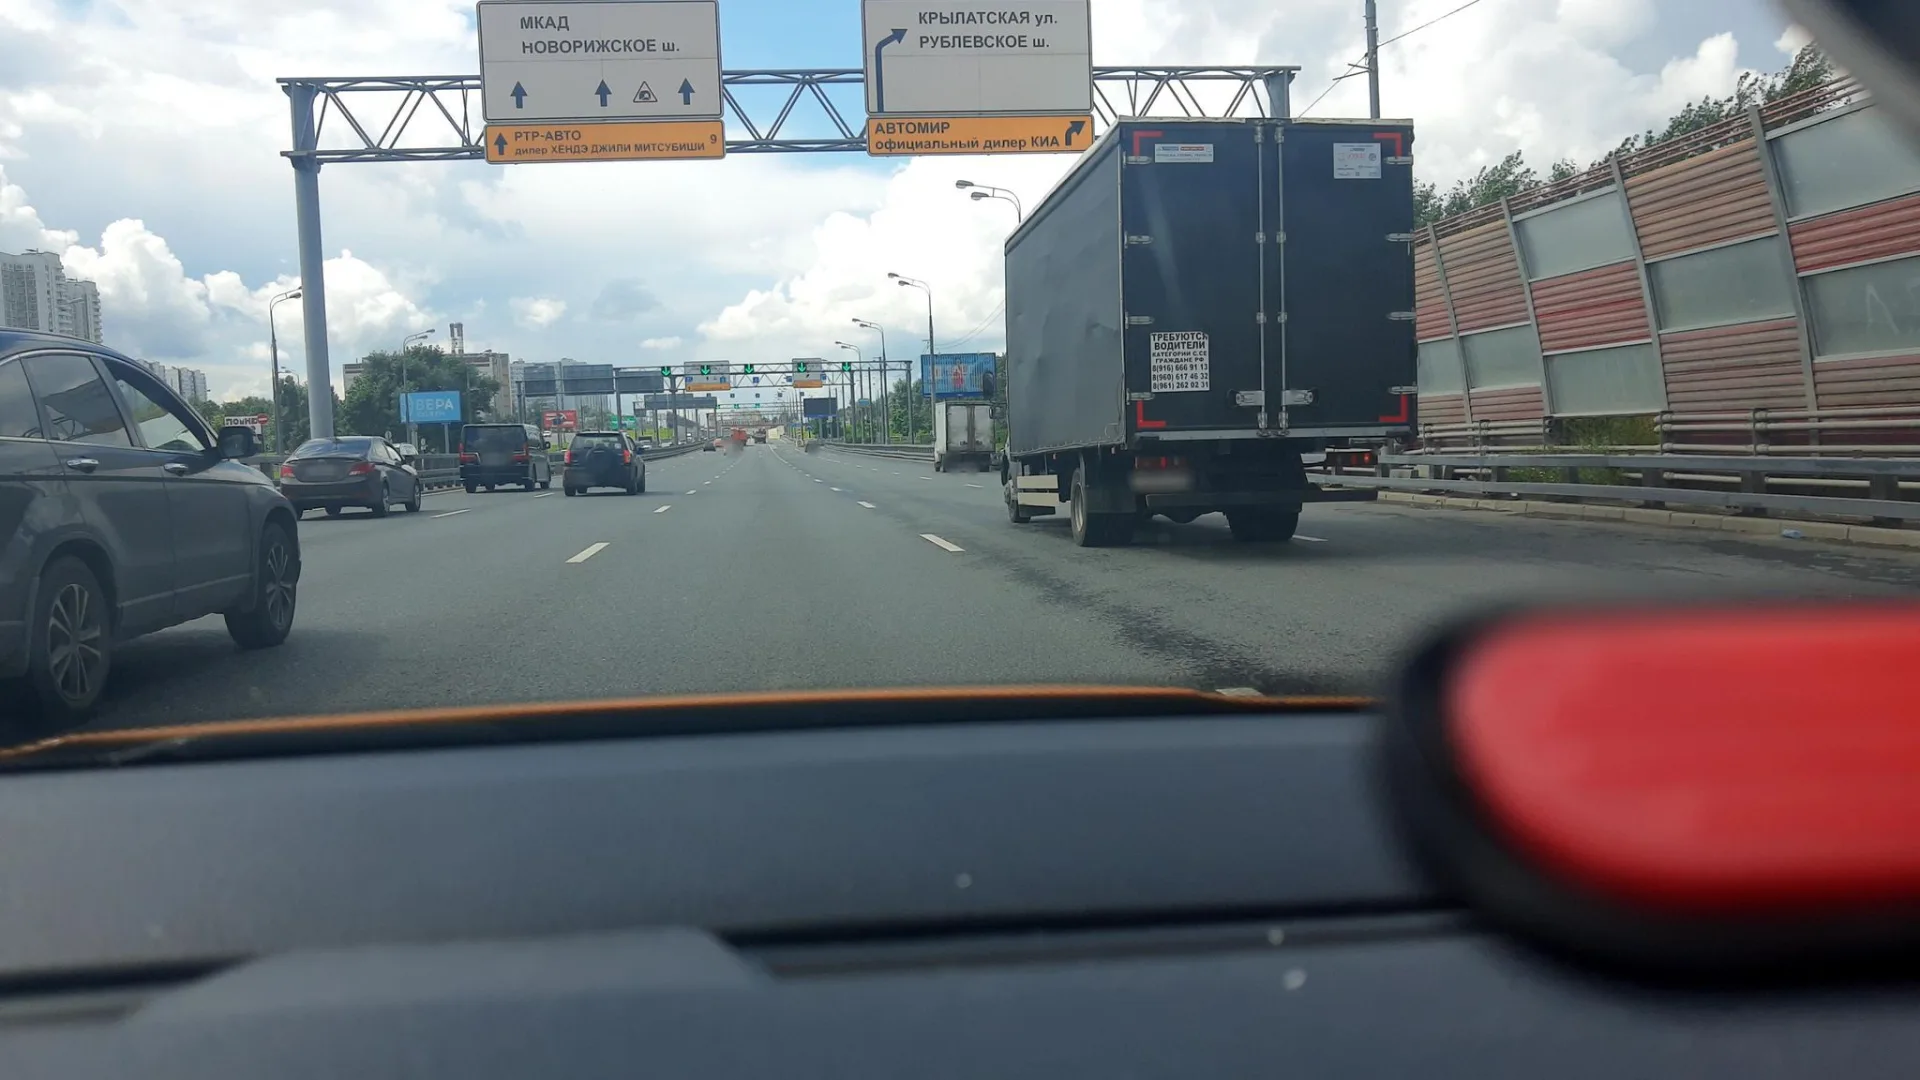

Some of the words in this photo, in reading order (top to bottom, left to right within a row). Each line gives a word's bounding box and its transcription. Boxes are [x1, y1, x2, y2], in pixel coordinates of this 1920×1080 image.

[520, 15, 570, 31] МКАД
[918, 11, 1031, 25] КРЫЛАТСКАЯ
[1034, 13, 1058, 27] ул.
[522, 39, 656, 54] НОВОРИЖСКОЕ
[661, 40, 680, 52] ш.
[919, 35, 1028, 49] РУБЛЕВСКОЕ
[1032, 37, 1050, 48] ш.
[874, 121, 951, 135] АВТОМИР
[514, 130, 582, 142] РТР-АВТО
[709, 133, 718, 144] 9
[515, 146, 548, 156] дилер
[634, 142, 705, 152] МИТСУБИШИ
[875, 137, 980, 152] официальный
[983, 138, 1027, 150] дилер
[1031, 136, 1060, 148] КИА
[1152, 333, 1208, 341] ТРЕБУЮТСЯ
[1154, 342, 1205, 351] ВОДИТЕЛИ
[1152, 364, 1174, 373] 8(916)
[1190, 363, 1198, 371] 91
[1200, 372, 1208, 380] 32
[417, 399, 453, 410] ВЕРА
